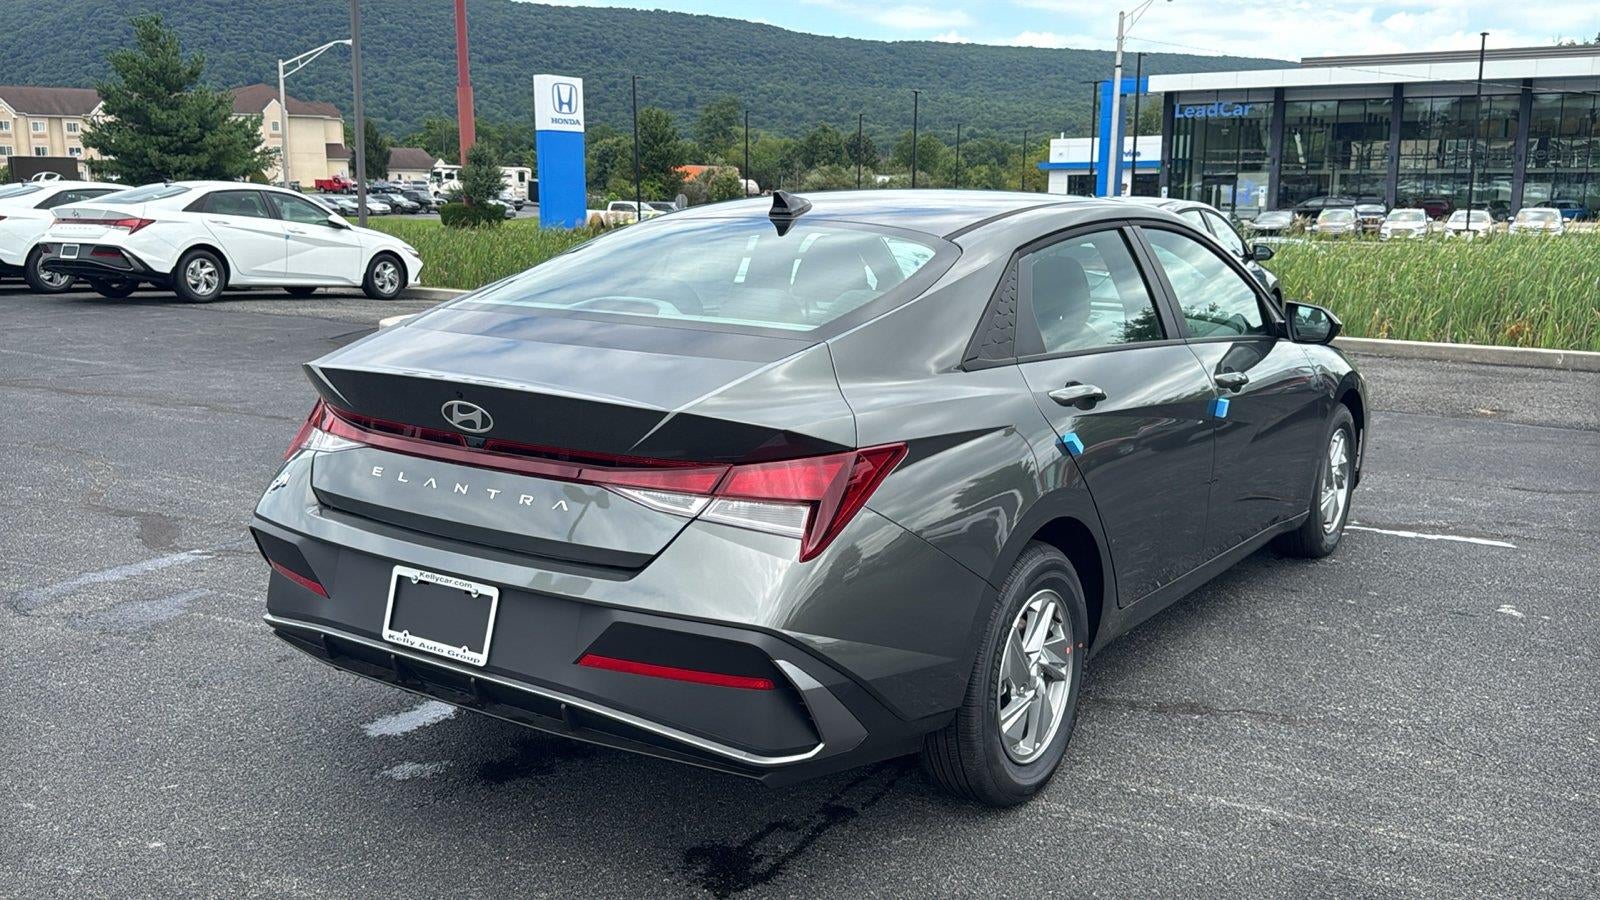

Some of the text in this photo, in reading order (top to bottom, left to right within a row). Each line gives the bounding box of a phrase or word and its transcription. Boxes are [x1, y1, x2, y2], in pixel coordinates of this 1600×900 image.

[1174, 101, 1253, 118] LeadCar
[551, 117, 582, 126] HONDA
[371, 466, 569, 512] ELANTRA
[419, 571, 473, 589] Kellycar.com
[388, 633, 481, 664] Kelly Auto Group
